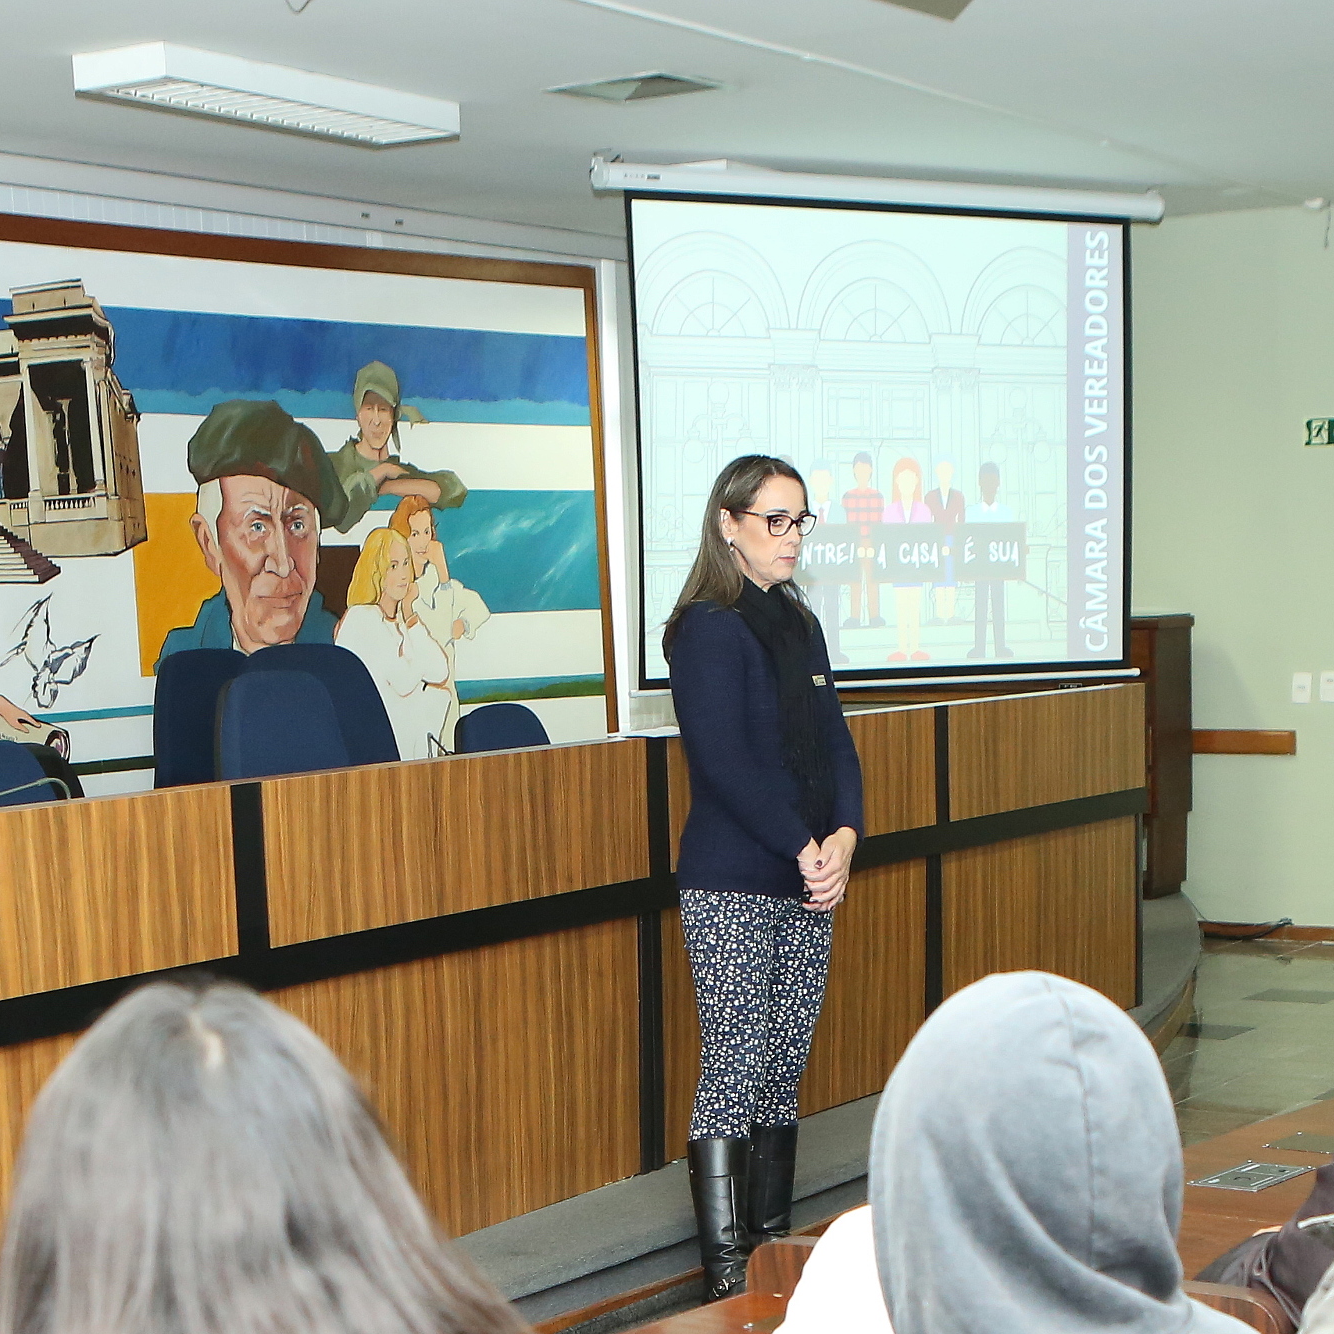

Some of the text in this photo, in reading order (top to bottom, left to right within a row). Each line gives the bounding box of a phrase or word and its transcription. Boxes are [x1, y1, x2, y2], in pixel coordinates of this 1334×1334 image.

[798, 536, 1020, 570] NTRE! A CASA É SUA
[1078, 230, 1110, 653] CÂMARA DOS VEREADORES
